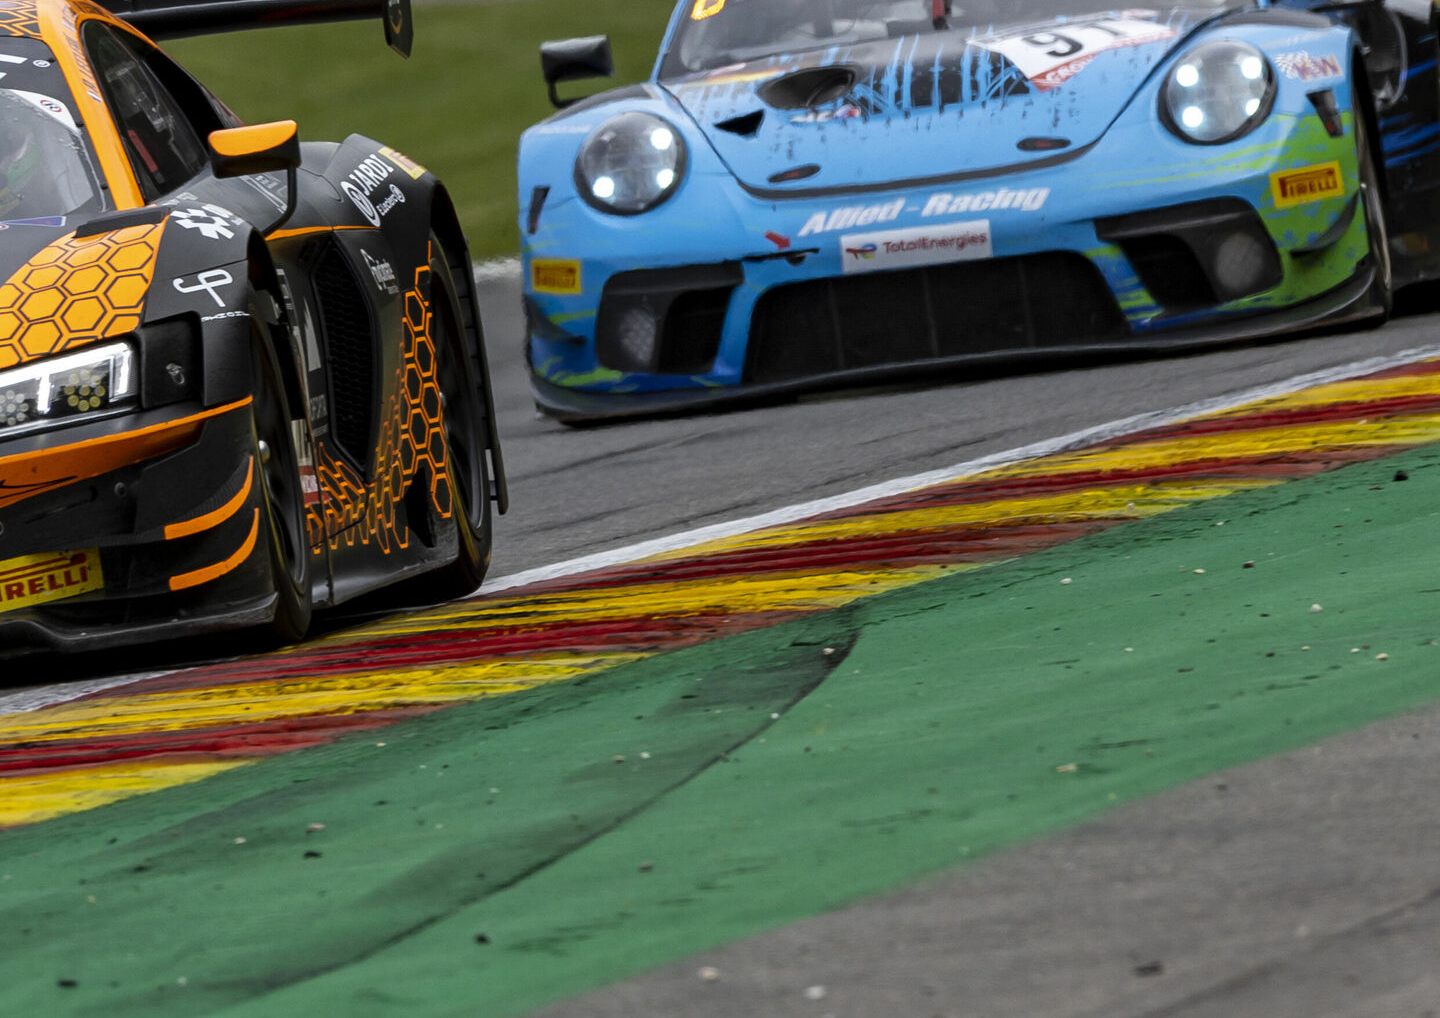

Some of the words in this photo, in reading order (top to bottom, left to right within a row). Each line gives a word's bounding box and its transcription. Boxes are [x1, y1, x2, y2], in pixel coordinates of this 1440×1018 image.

[349, 154, 394, 196] JARDI
[798, 198, 906, 237] Allied
[921, 188, 1050, 217] Racing
[882, 231, 988, 255] TotalEnergies
